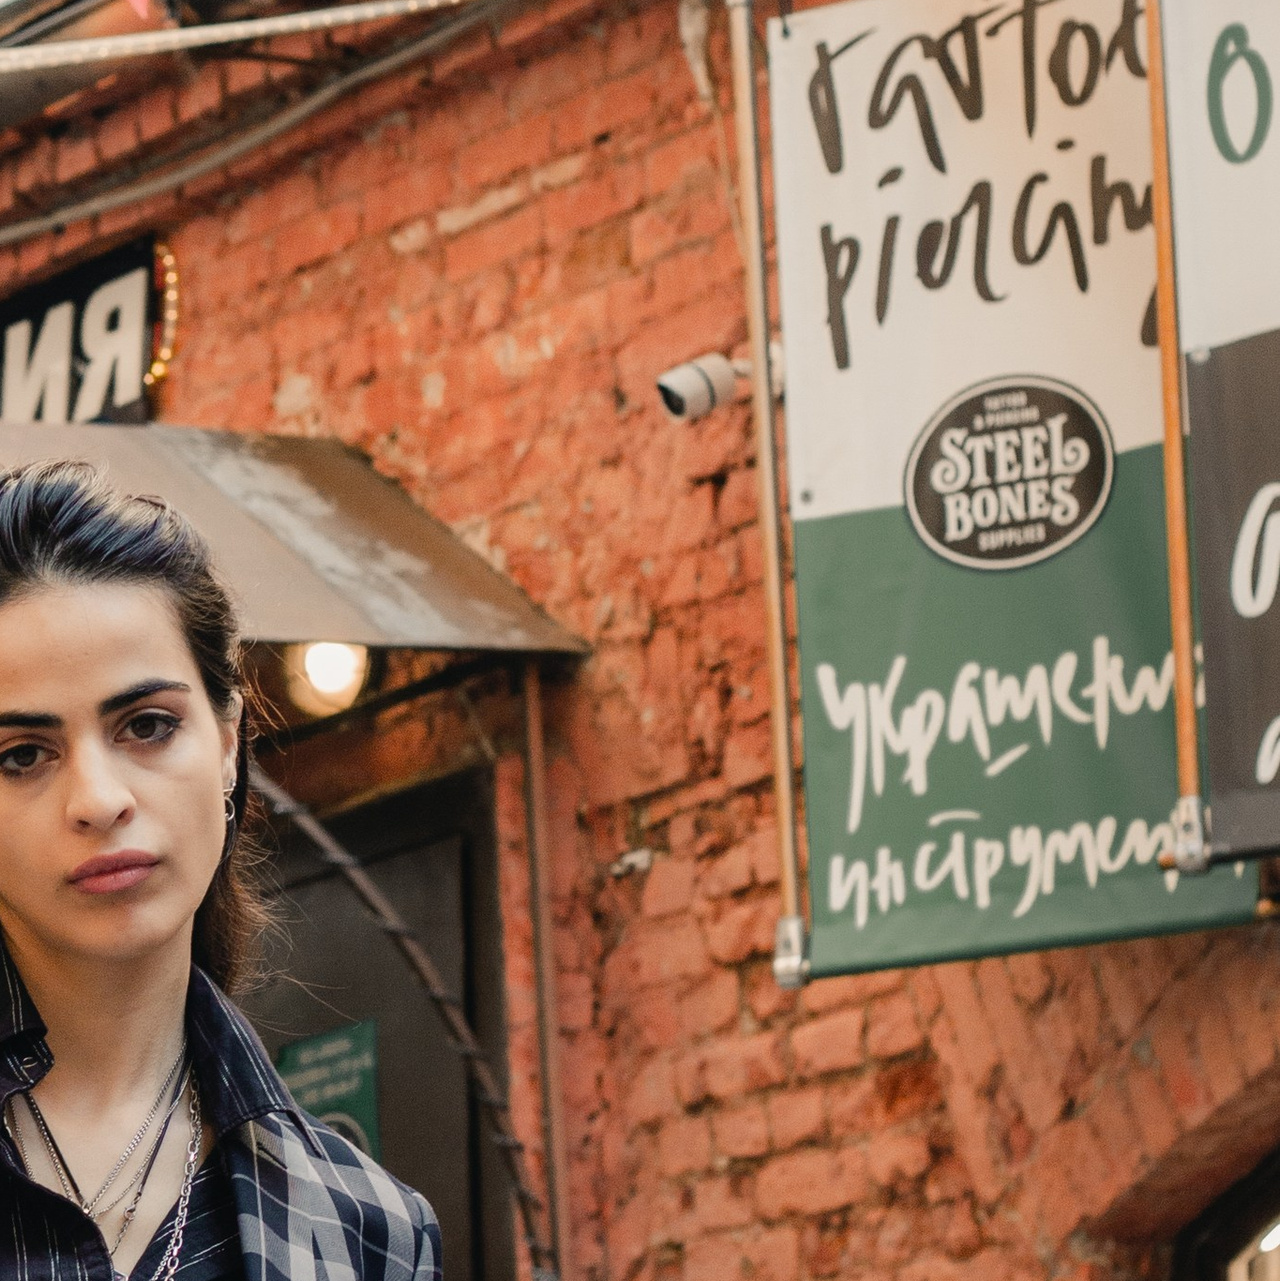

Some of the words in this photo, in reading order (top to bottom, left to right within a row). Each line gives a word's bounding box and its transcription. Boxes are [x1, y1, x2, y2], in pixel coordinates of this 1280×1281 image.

[930, 412, 1091, 494] STEEL
[943, 475, 1080, 542] BONES
[829, 809, 1214, 929] инструмен
